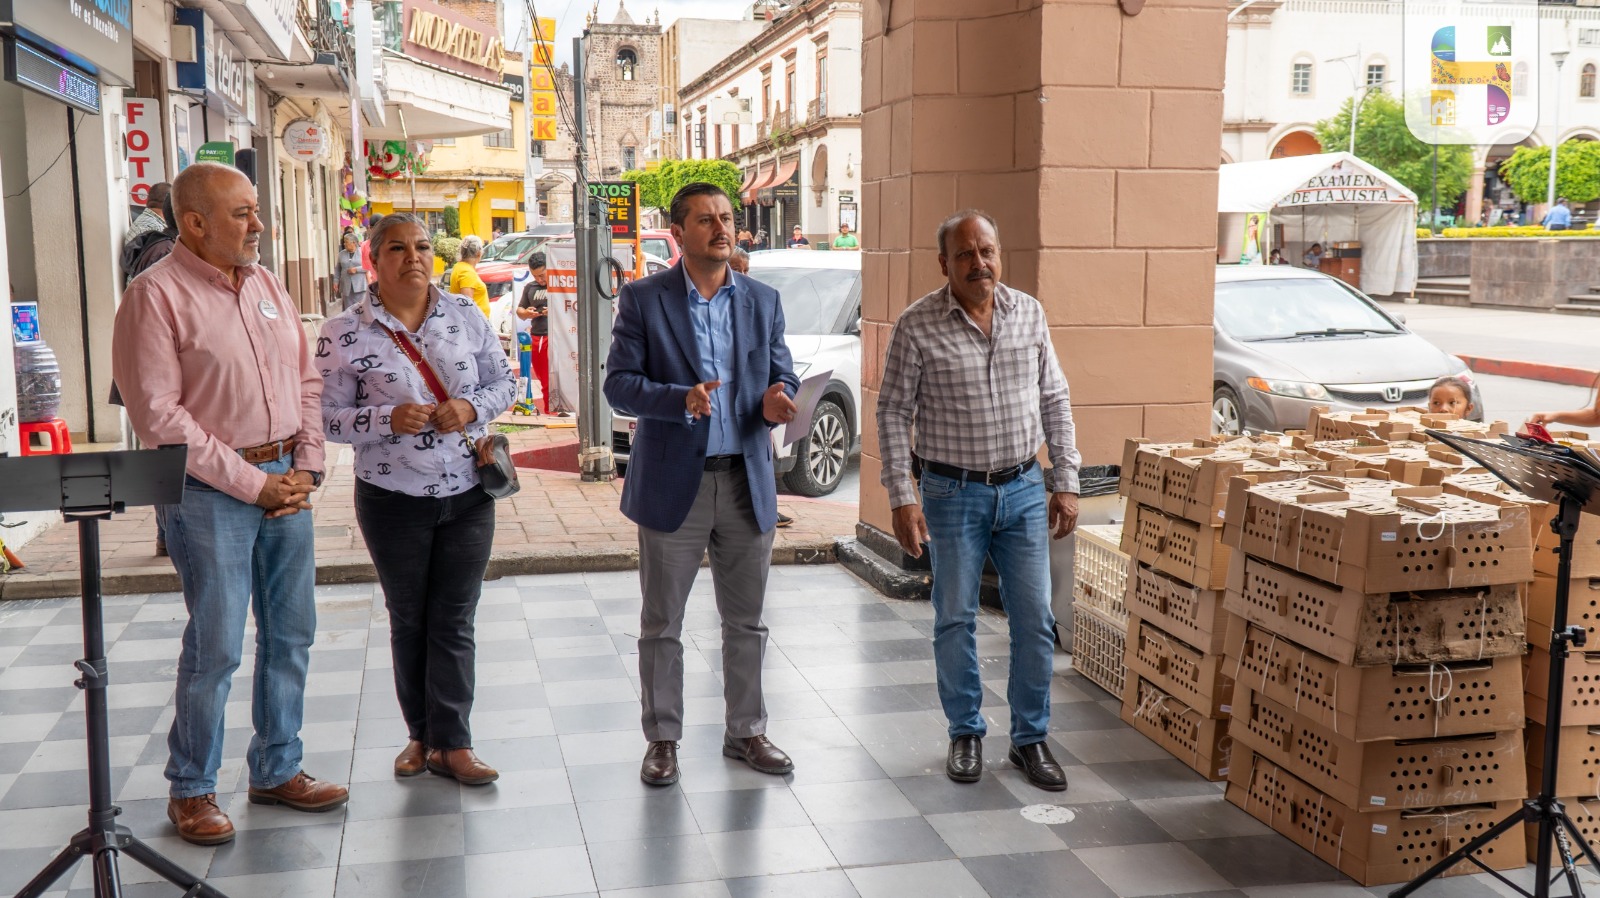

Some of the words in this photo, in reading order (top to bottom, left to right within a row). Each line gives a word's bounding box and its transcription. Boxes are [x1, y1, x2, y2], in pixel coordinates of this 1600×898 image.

[84, 9, 91, 25] es
[407, 7, 504, 72] MODATELAS
[218, 39, 244, 107] telcel
[127, 103, 151, 206] FOTO
[1307, 174, 1377, 188] EXAMEN
[588, 184, 631, 197] OTOS
[1291, 191, 1311, 204] DE
[1316, 190, 1335, 202] LA
[1340, 190, 1389, 202] VISTA
[609, 197, 631, 206] PEL
[607, 207, 628, 220] TE
